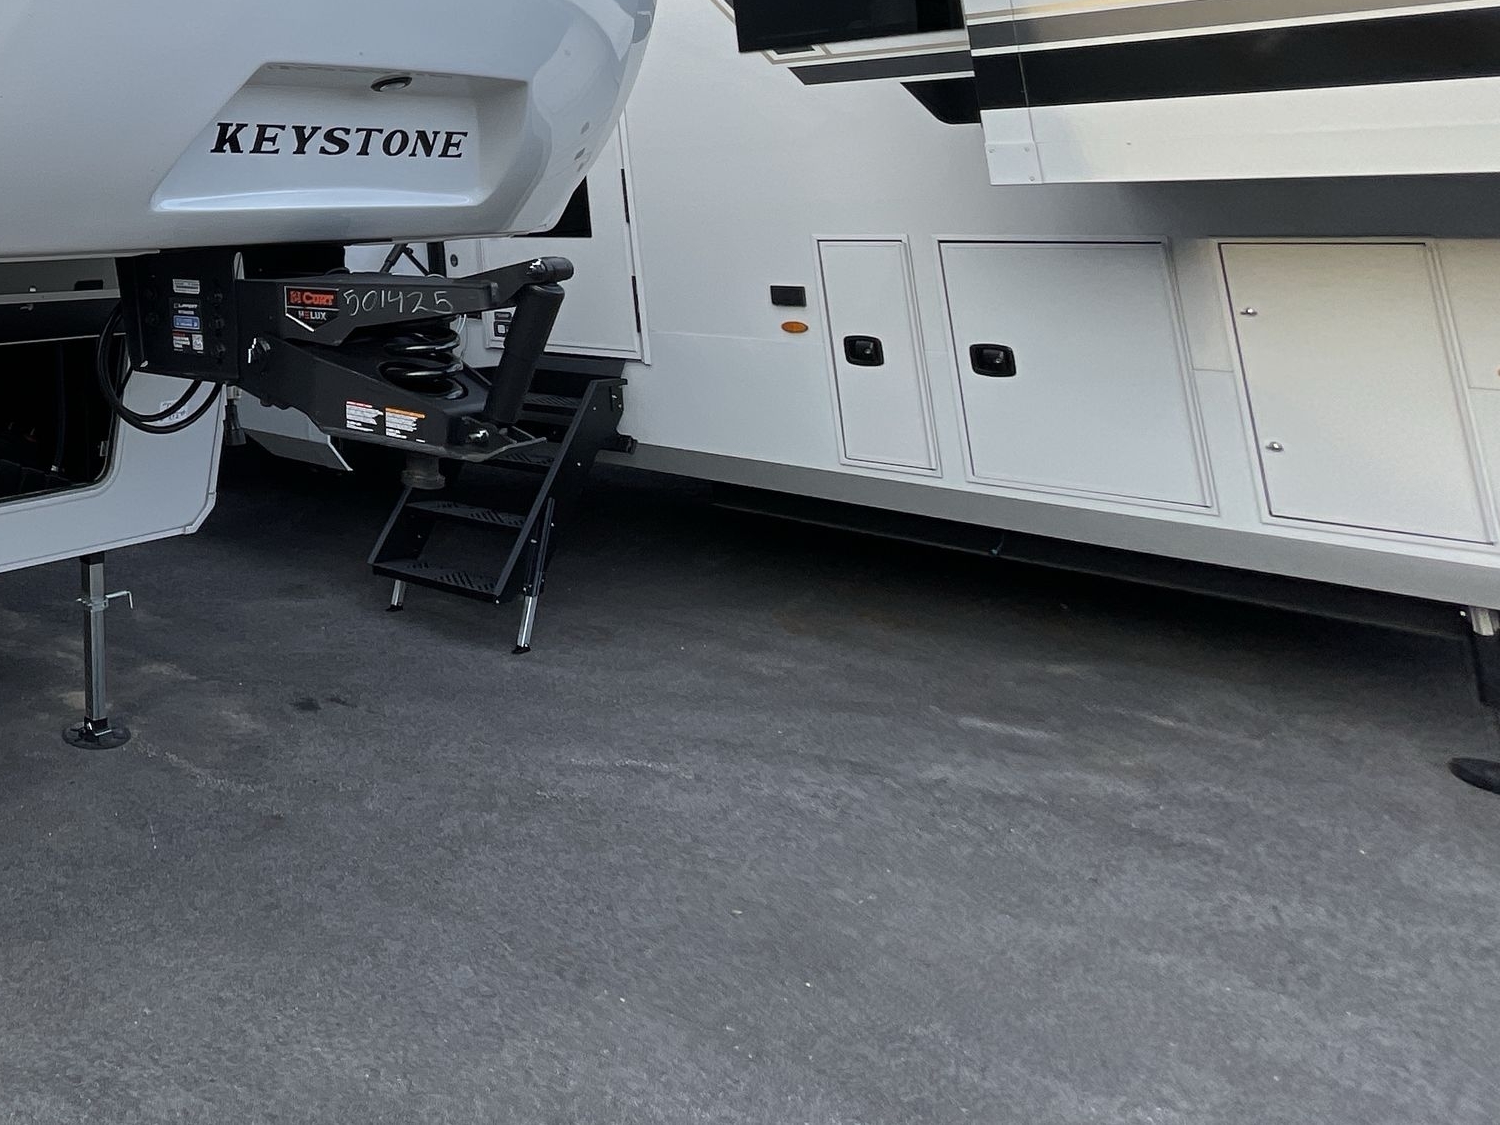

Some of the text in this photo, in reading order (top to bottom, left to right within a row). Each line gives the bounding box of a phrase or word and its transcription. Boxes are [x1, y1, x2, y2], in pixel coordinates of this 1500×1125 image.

[209, 122, 468, 159] KEYSTONE
[298, 310, 327, 321] HELUX
[343, 289, 454, 316] 501425
